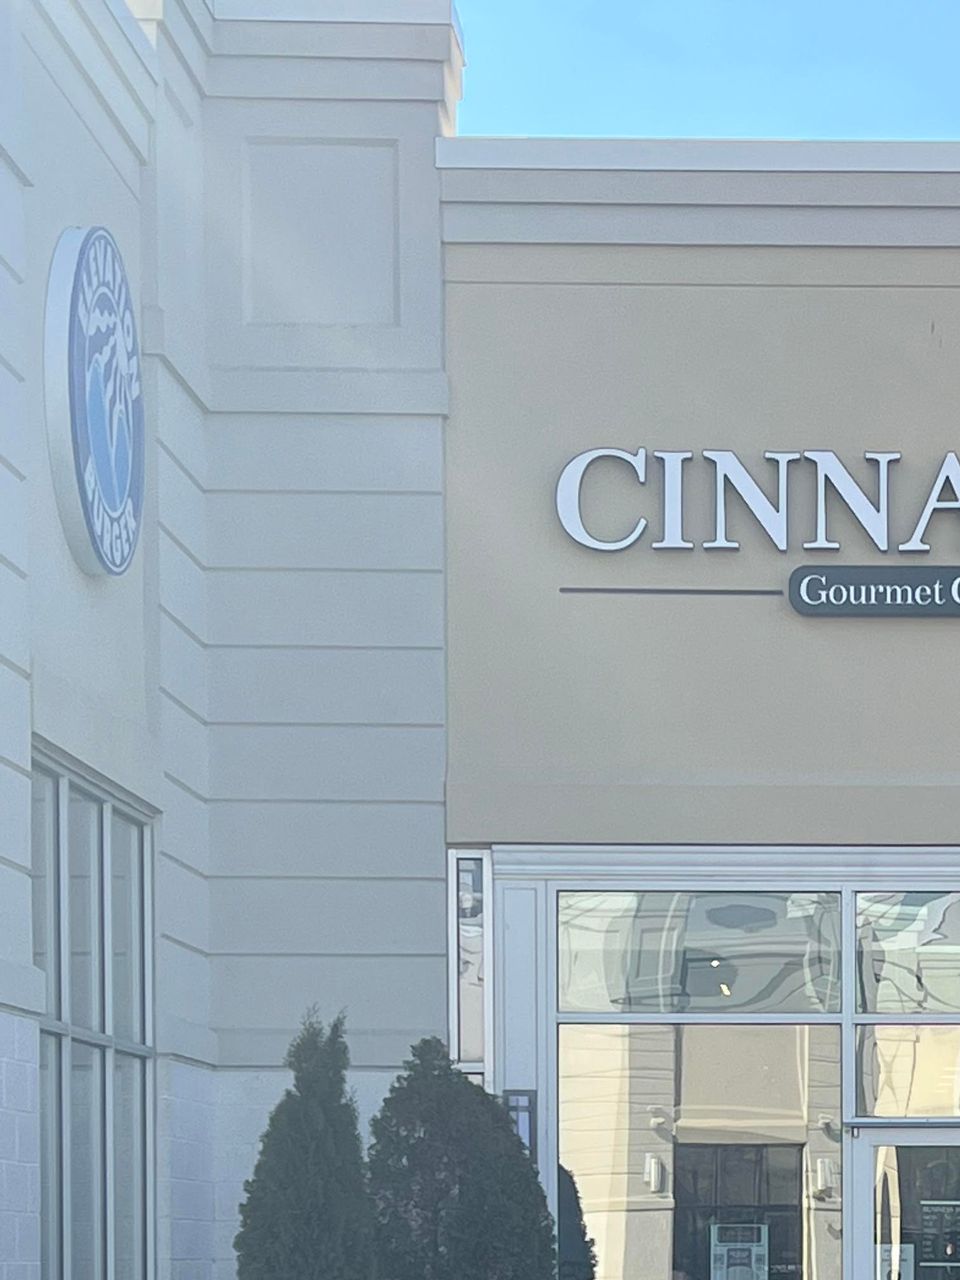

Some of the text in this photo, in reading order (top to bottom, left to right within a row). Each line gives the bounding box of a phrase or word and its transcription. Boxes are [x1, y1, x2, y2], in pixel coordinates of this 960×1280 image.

[78, 237, 140, 401] ELEVATION
[84, 456, 137, 568] BURGER
[799, 574, 946, 608] Gourmet
